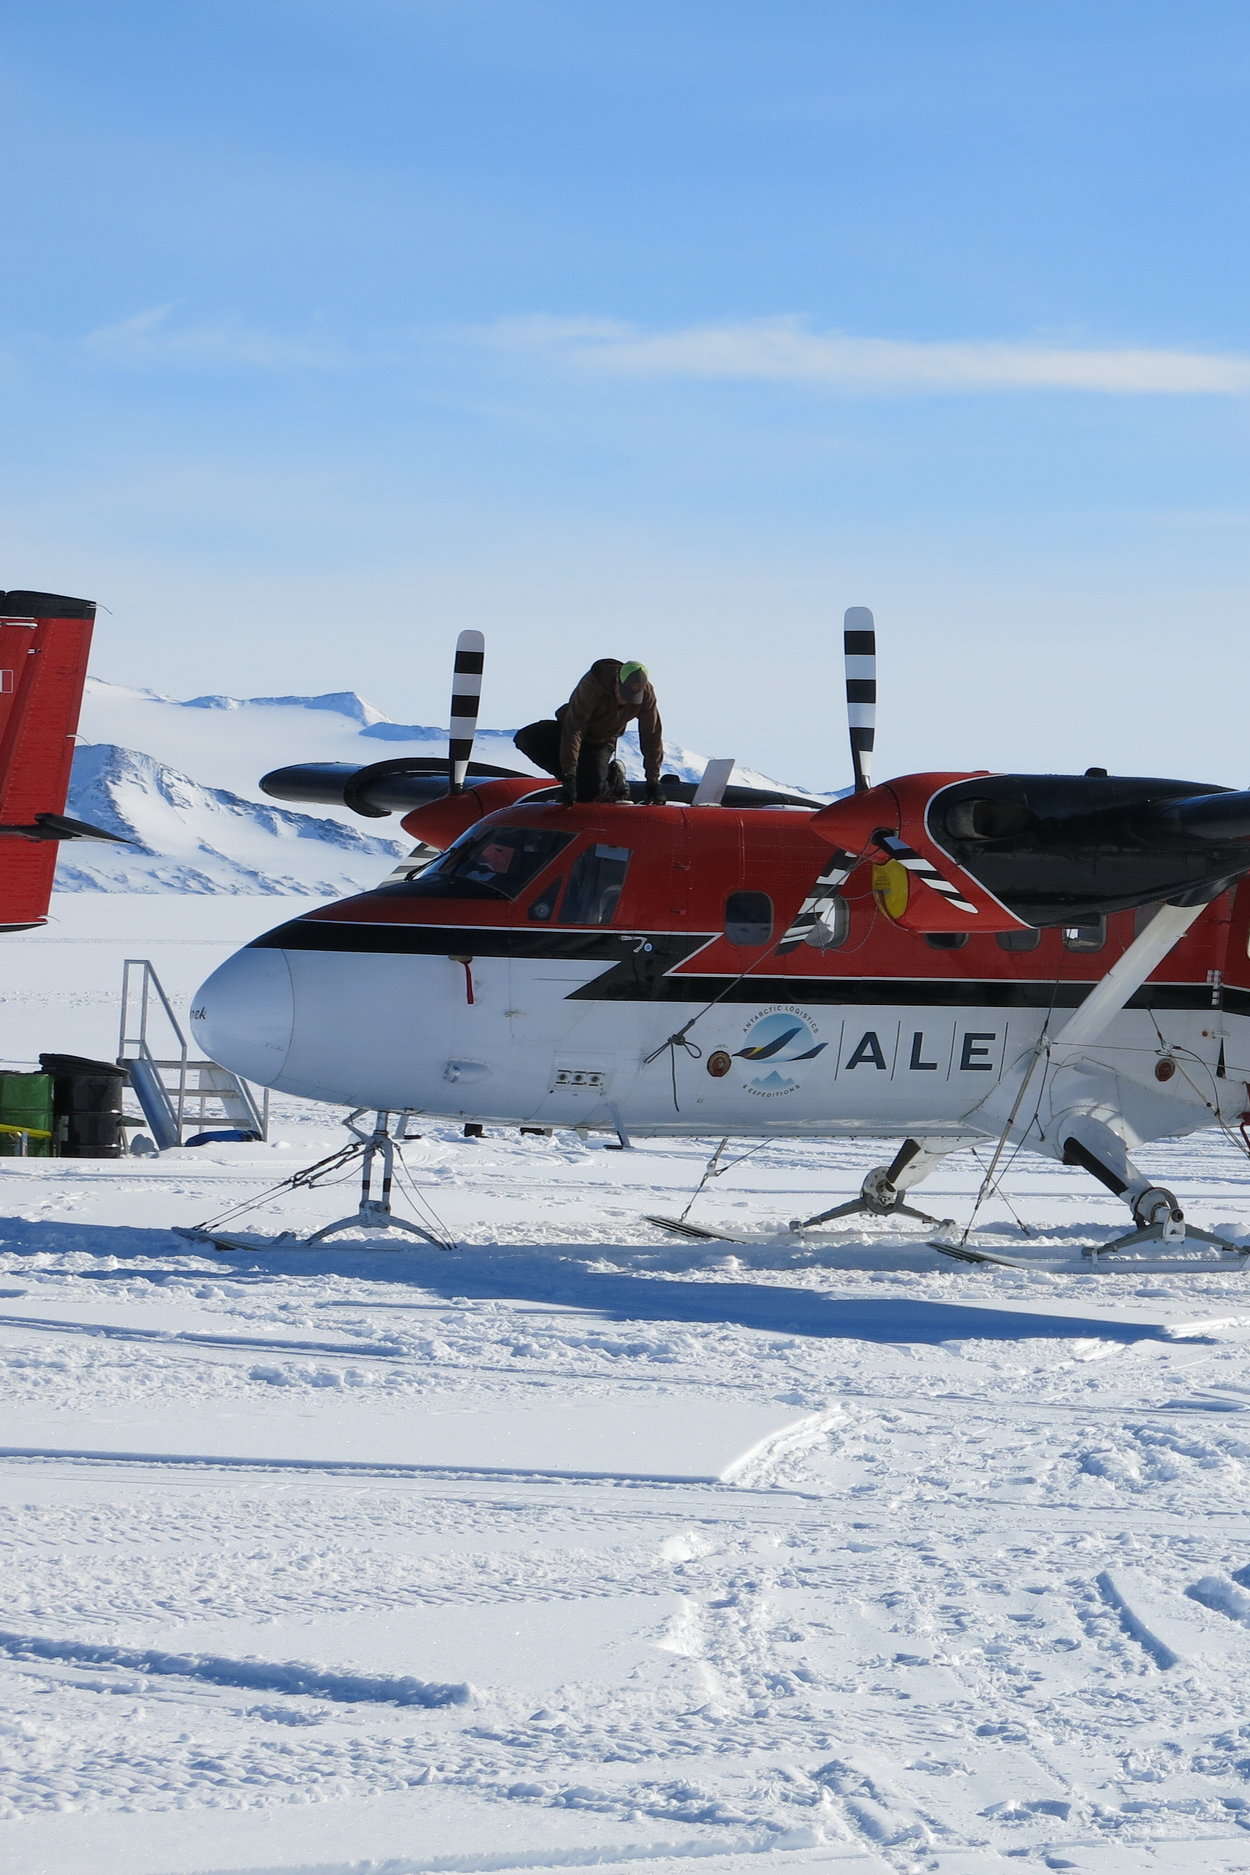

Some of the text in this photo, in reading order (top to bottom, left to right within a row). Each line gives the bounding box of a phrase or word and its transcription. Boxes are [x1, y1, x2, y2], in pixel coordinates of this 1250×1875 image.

[742, 1005, 820, 1034] ANTARCTIC LOGISTICS
[748, 1084, 801, 1098] EXPEDITIONS
